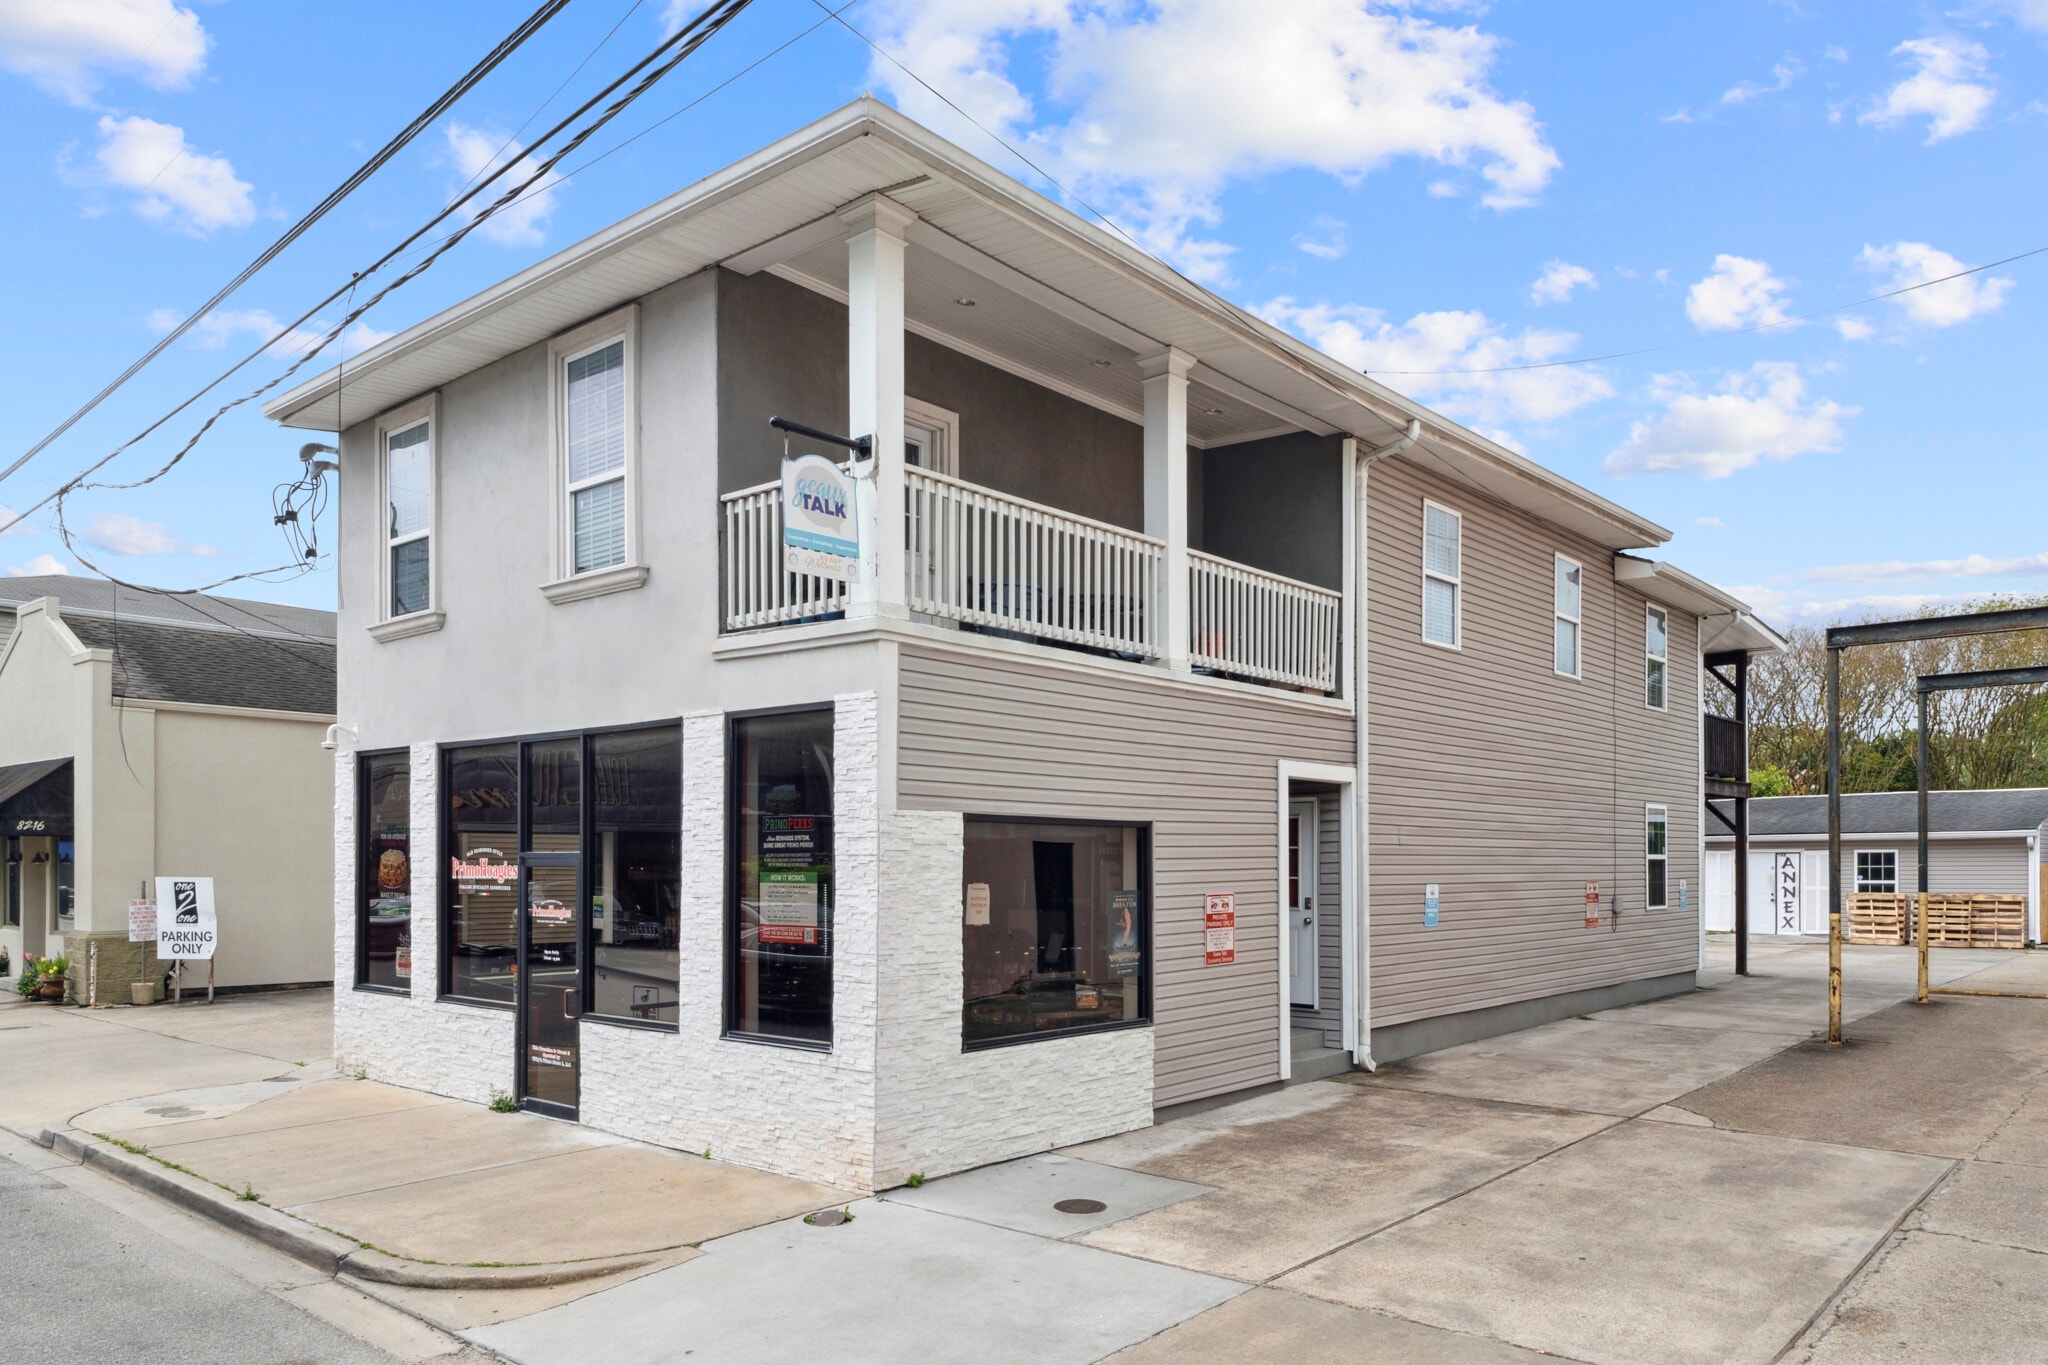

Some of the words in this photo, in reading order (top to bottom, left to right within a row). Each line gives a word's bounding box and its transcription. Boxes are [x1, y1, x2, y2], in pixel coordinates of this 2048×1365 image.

[803, 493, 847, 519] TALK
[17, 820, 45, 831] 8216
[452, 856, 519, 884] PrimoHoagies
[175, 882, 195, 891] one
[1781, 856, 1796, 929] ANNEX
[176, 890, 198, 916] 2
[177, 914, 198, 923] one
[1223, 919, 1234, 927] ONLY
[162, 931, 213, 942] PARKING
[172, 943, 203, 954] ONLY
